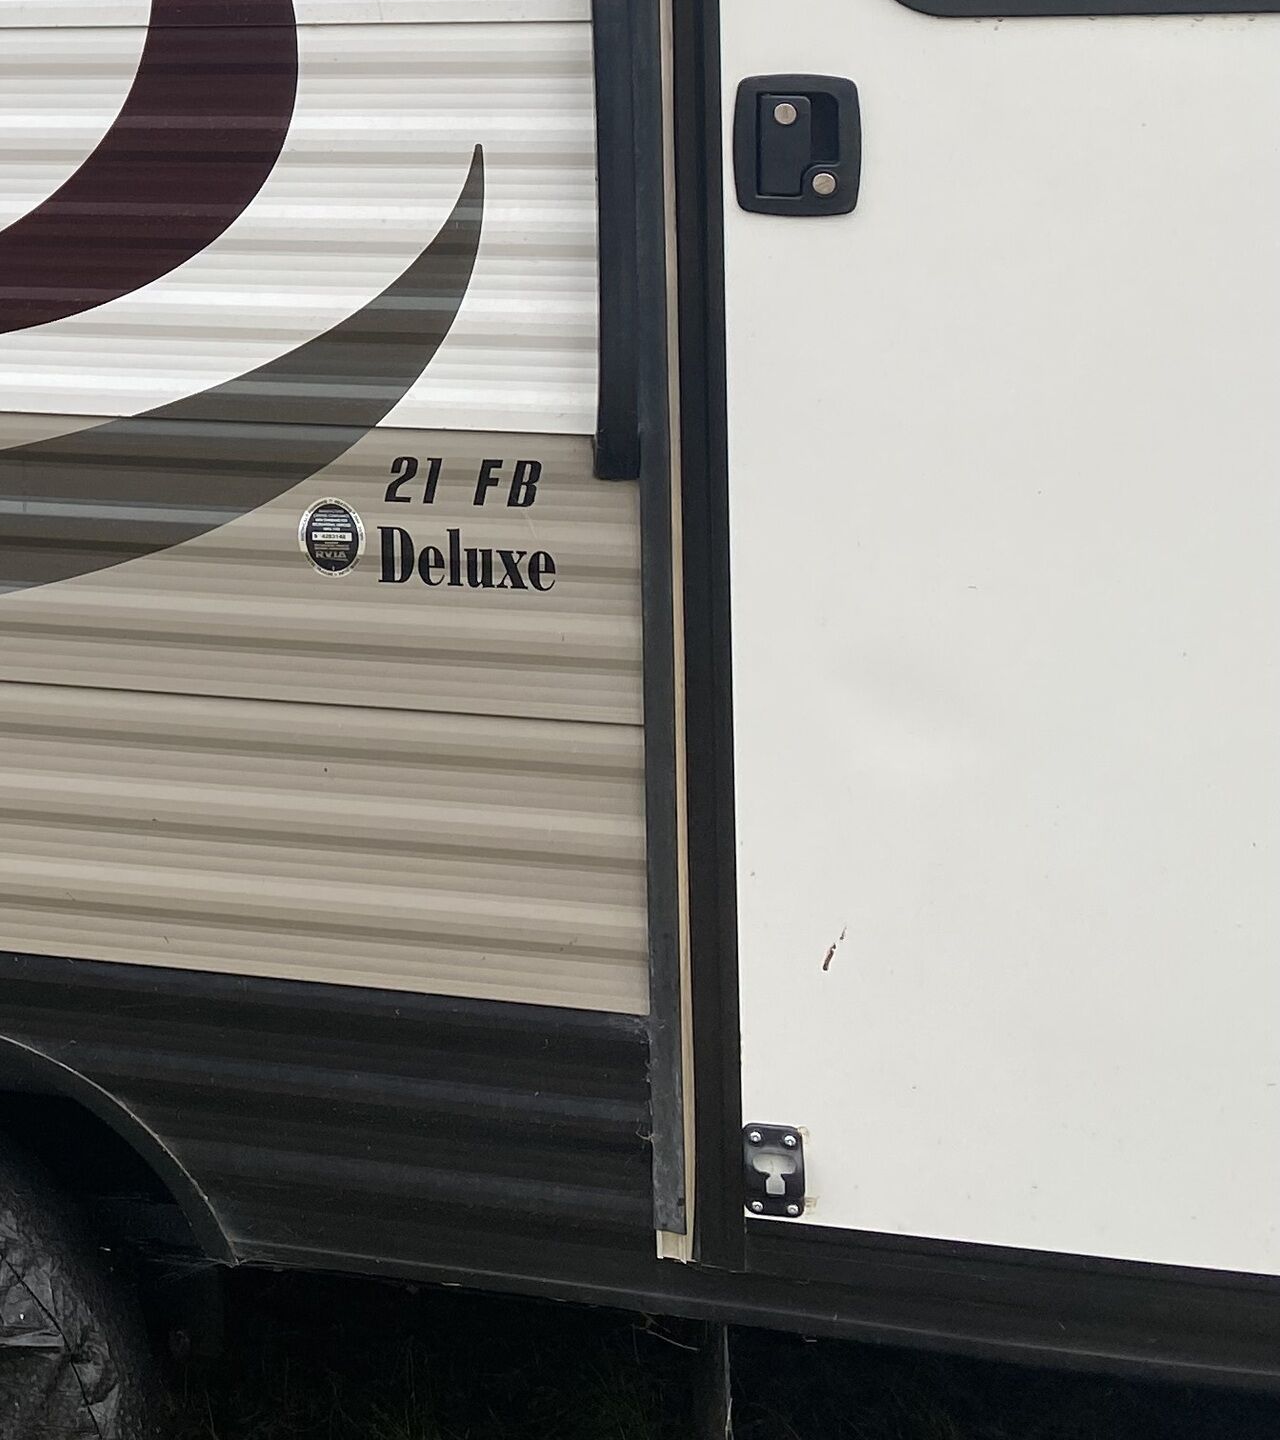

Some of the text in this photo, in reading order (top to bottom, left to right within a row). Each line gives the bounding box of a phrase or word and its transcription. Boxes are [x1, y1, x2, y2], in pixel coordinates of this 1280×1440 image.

[384, 456, 543, 507] 21 FB
[377, 526, 557, 591] Deluxe
